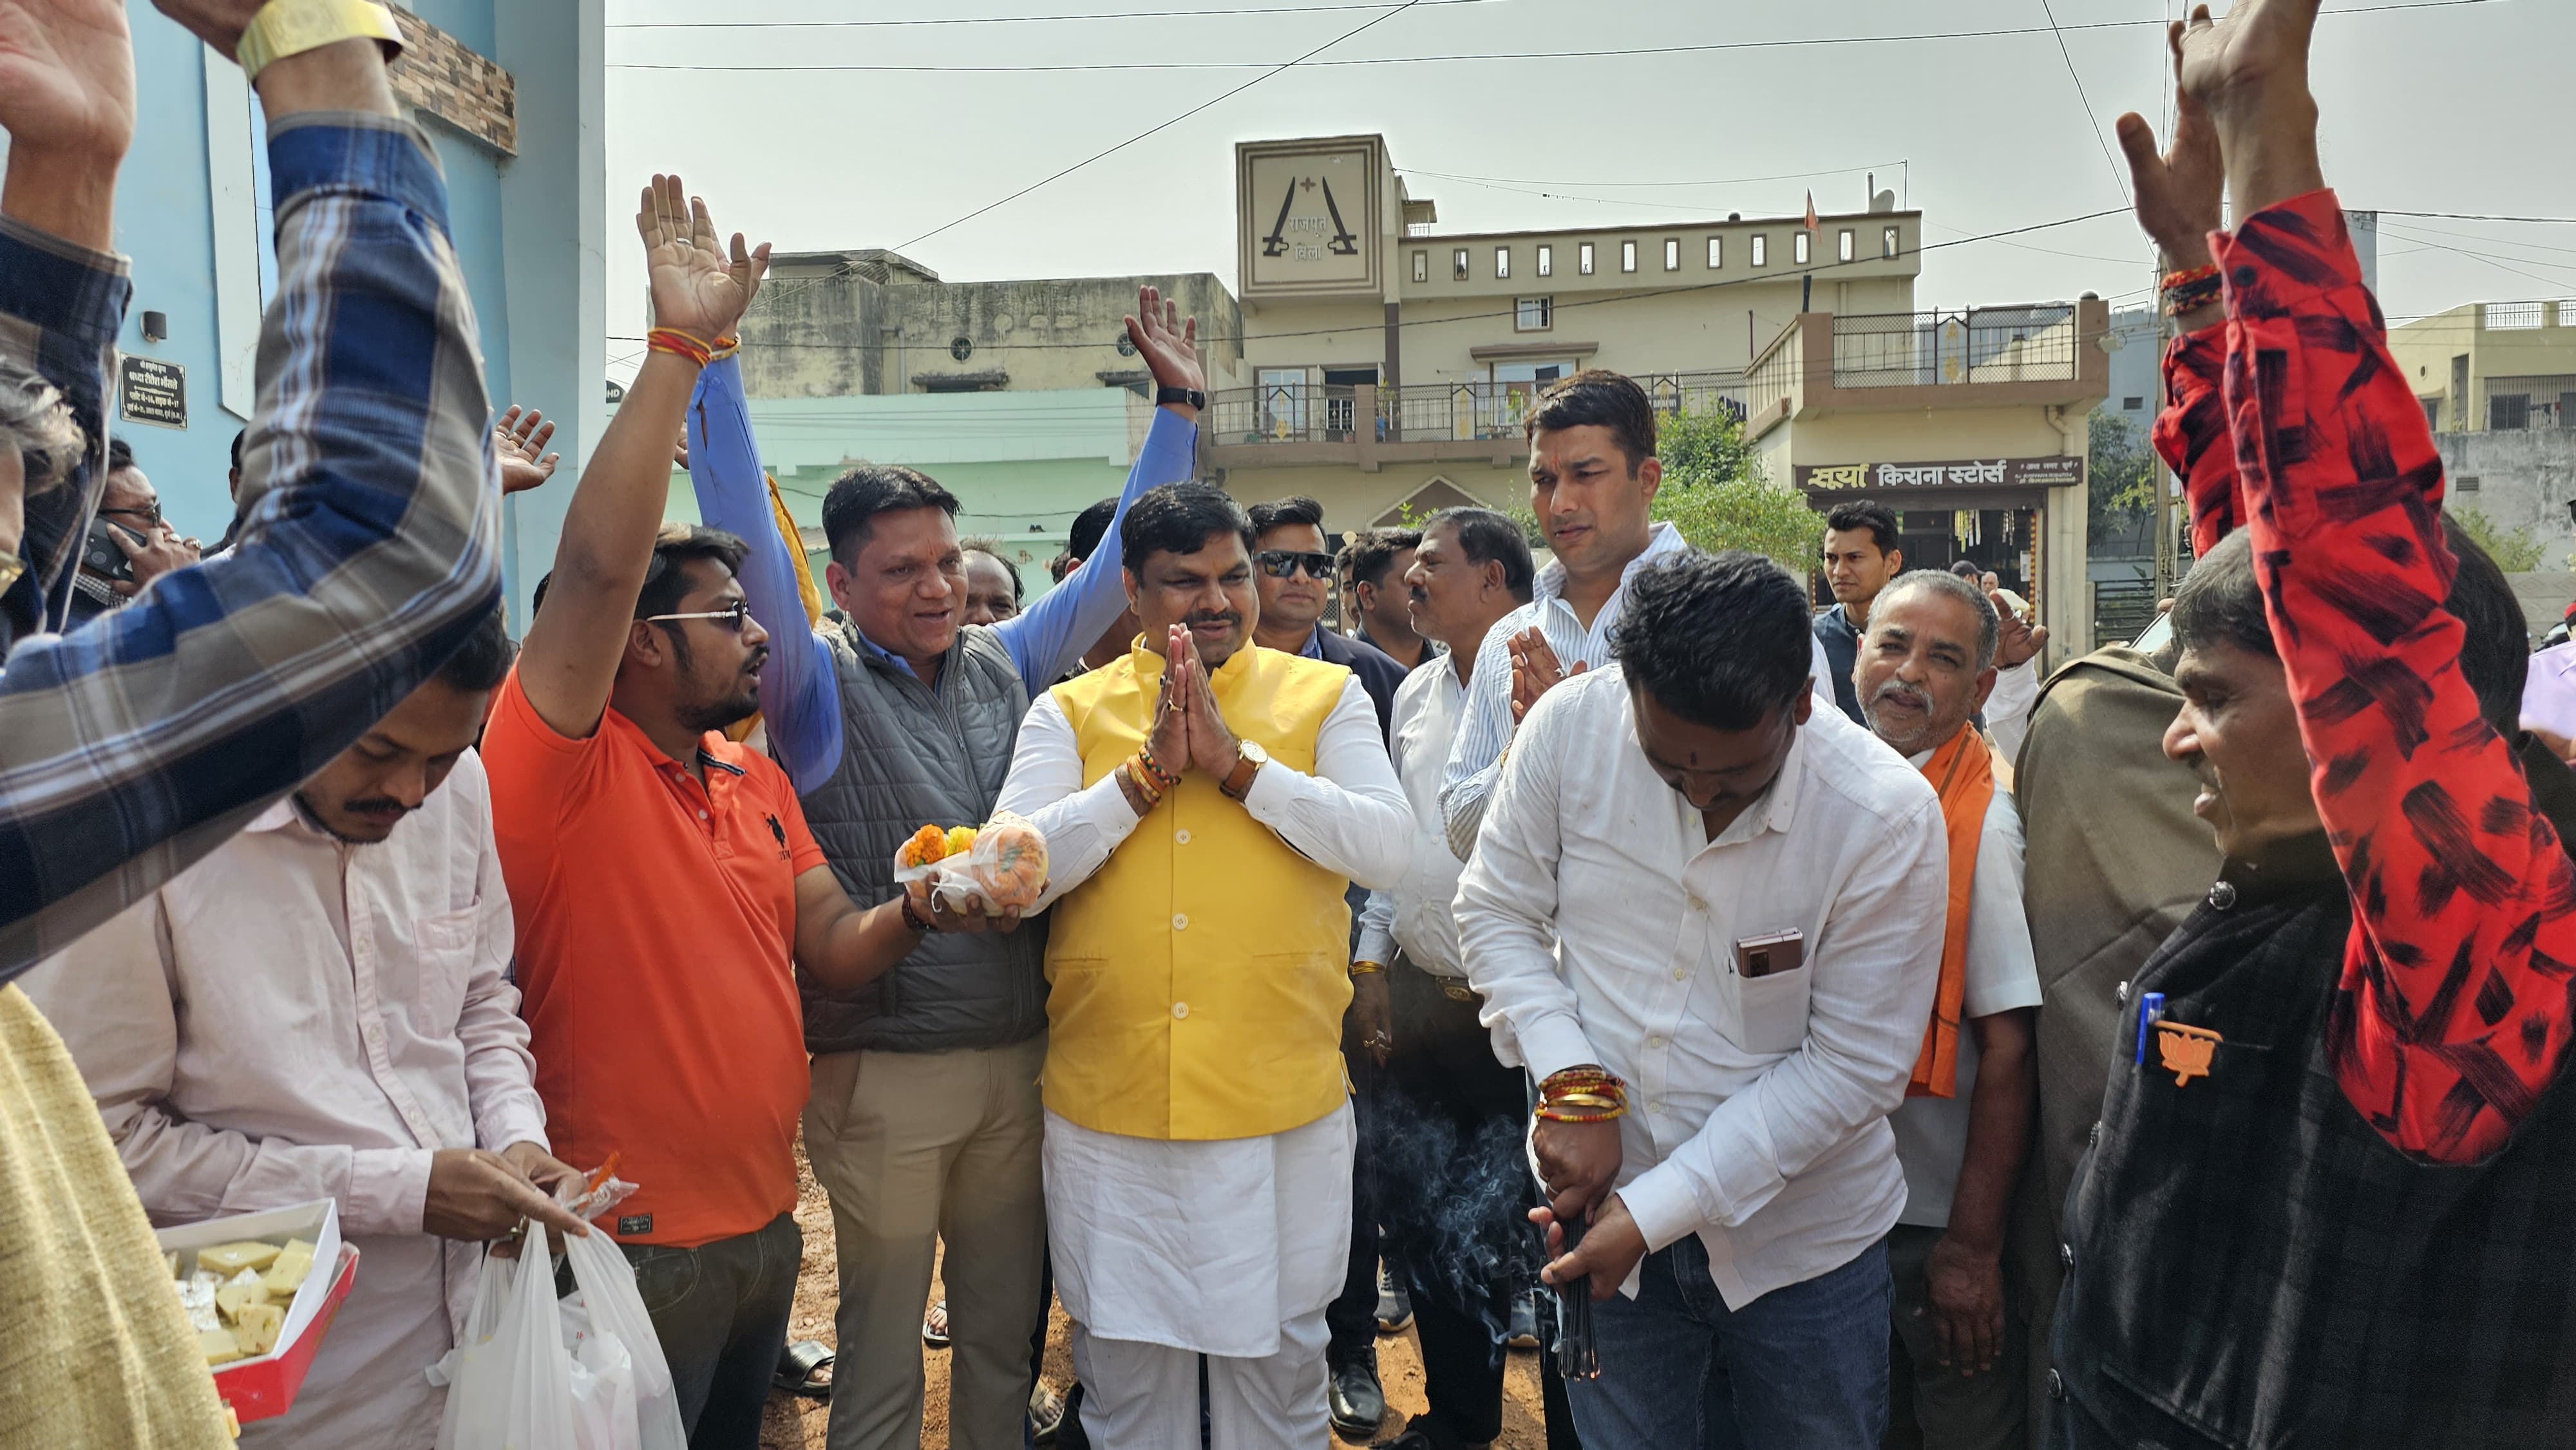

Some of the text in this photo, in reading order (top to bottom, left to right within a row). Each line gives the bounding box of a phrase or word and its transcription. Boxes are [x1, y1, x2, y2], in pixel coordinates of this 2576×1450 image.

[1289, 216, 1327, 237] राजपूत
[1294, 242, 1321, 260] विला
[607, 388, 620, 398] HD
[1808, 459, 2007, 490] सूर्या किराना स्टोर्स
